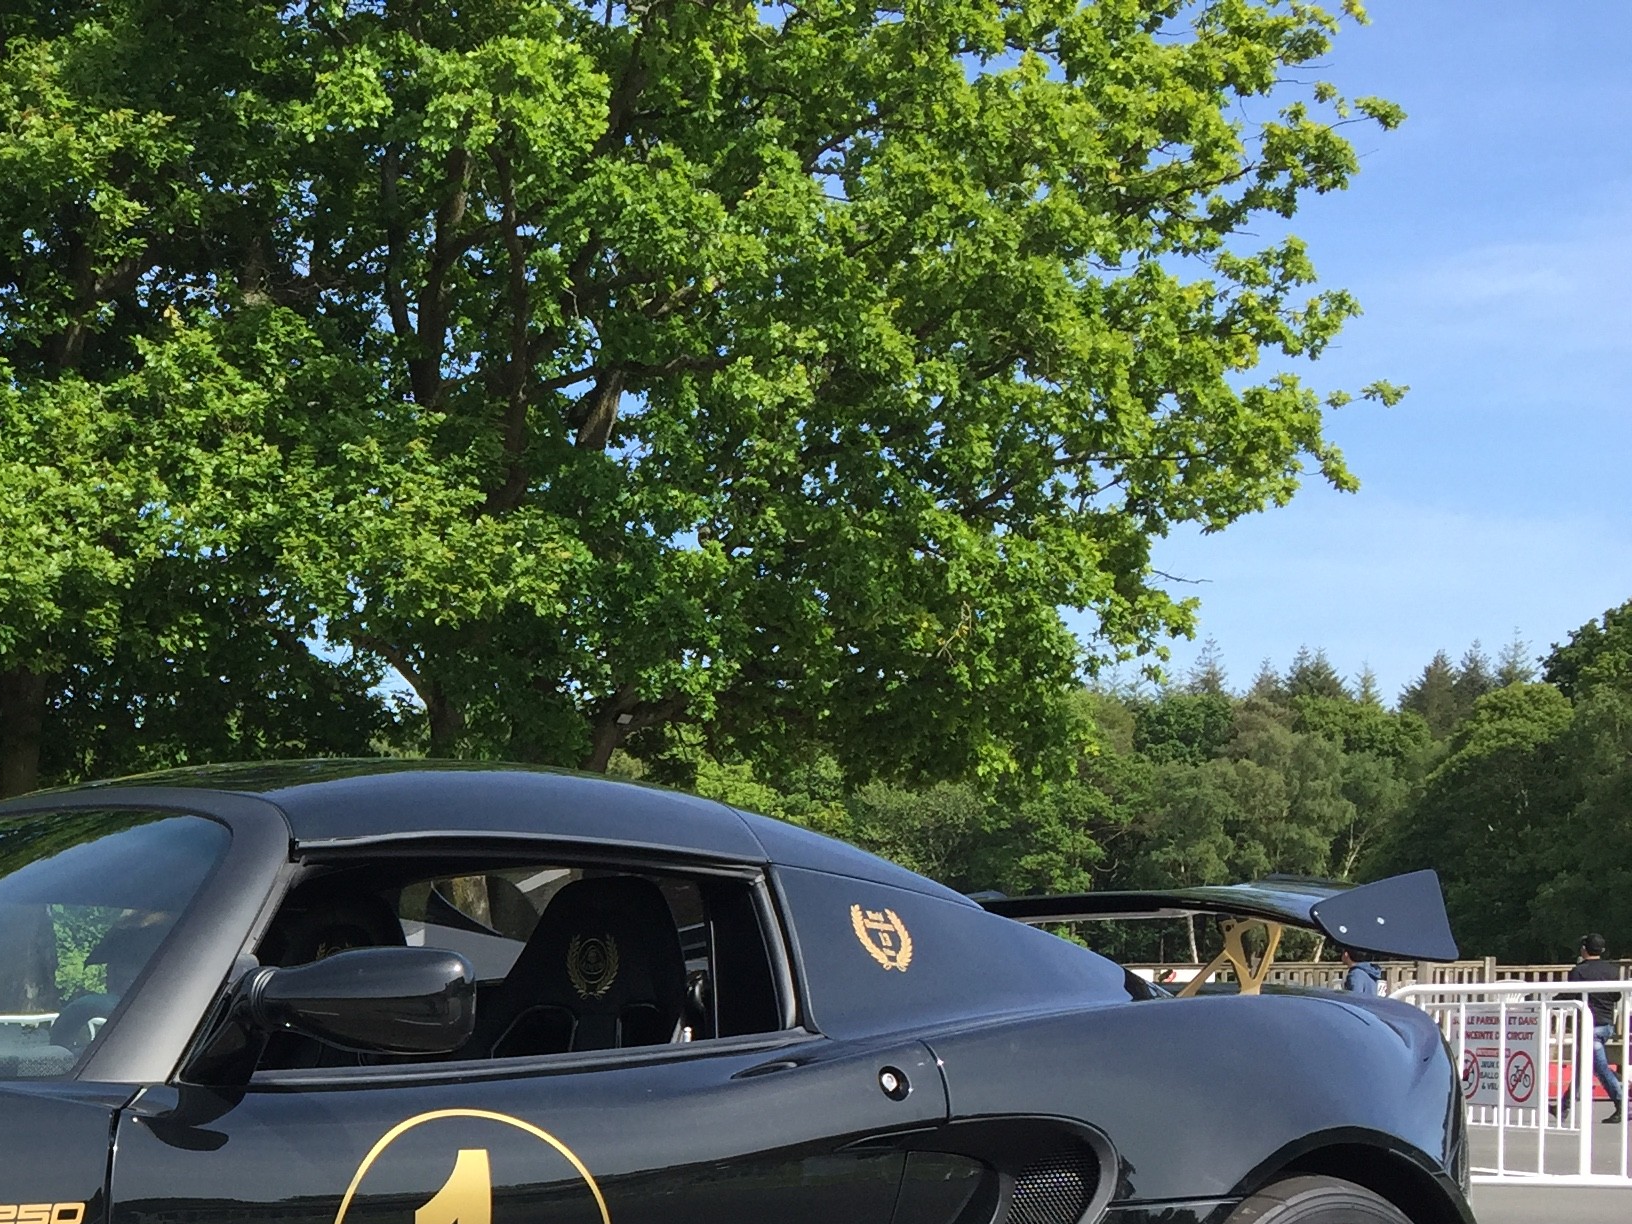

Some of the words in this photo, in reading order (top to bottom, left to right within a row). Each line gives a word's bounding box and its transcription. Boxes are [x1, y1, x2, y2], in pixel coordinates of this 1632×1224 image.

[1476, 1016, 1504, 1025] PARKIN
[1508, 1016, 1517, 1025] ET
[1506, 1031, 1535, 1041] CIRCUIT
